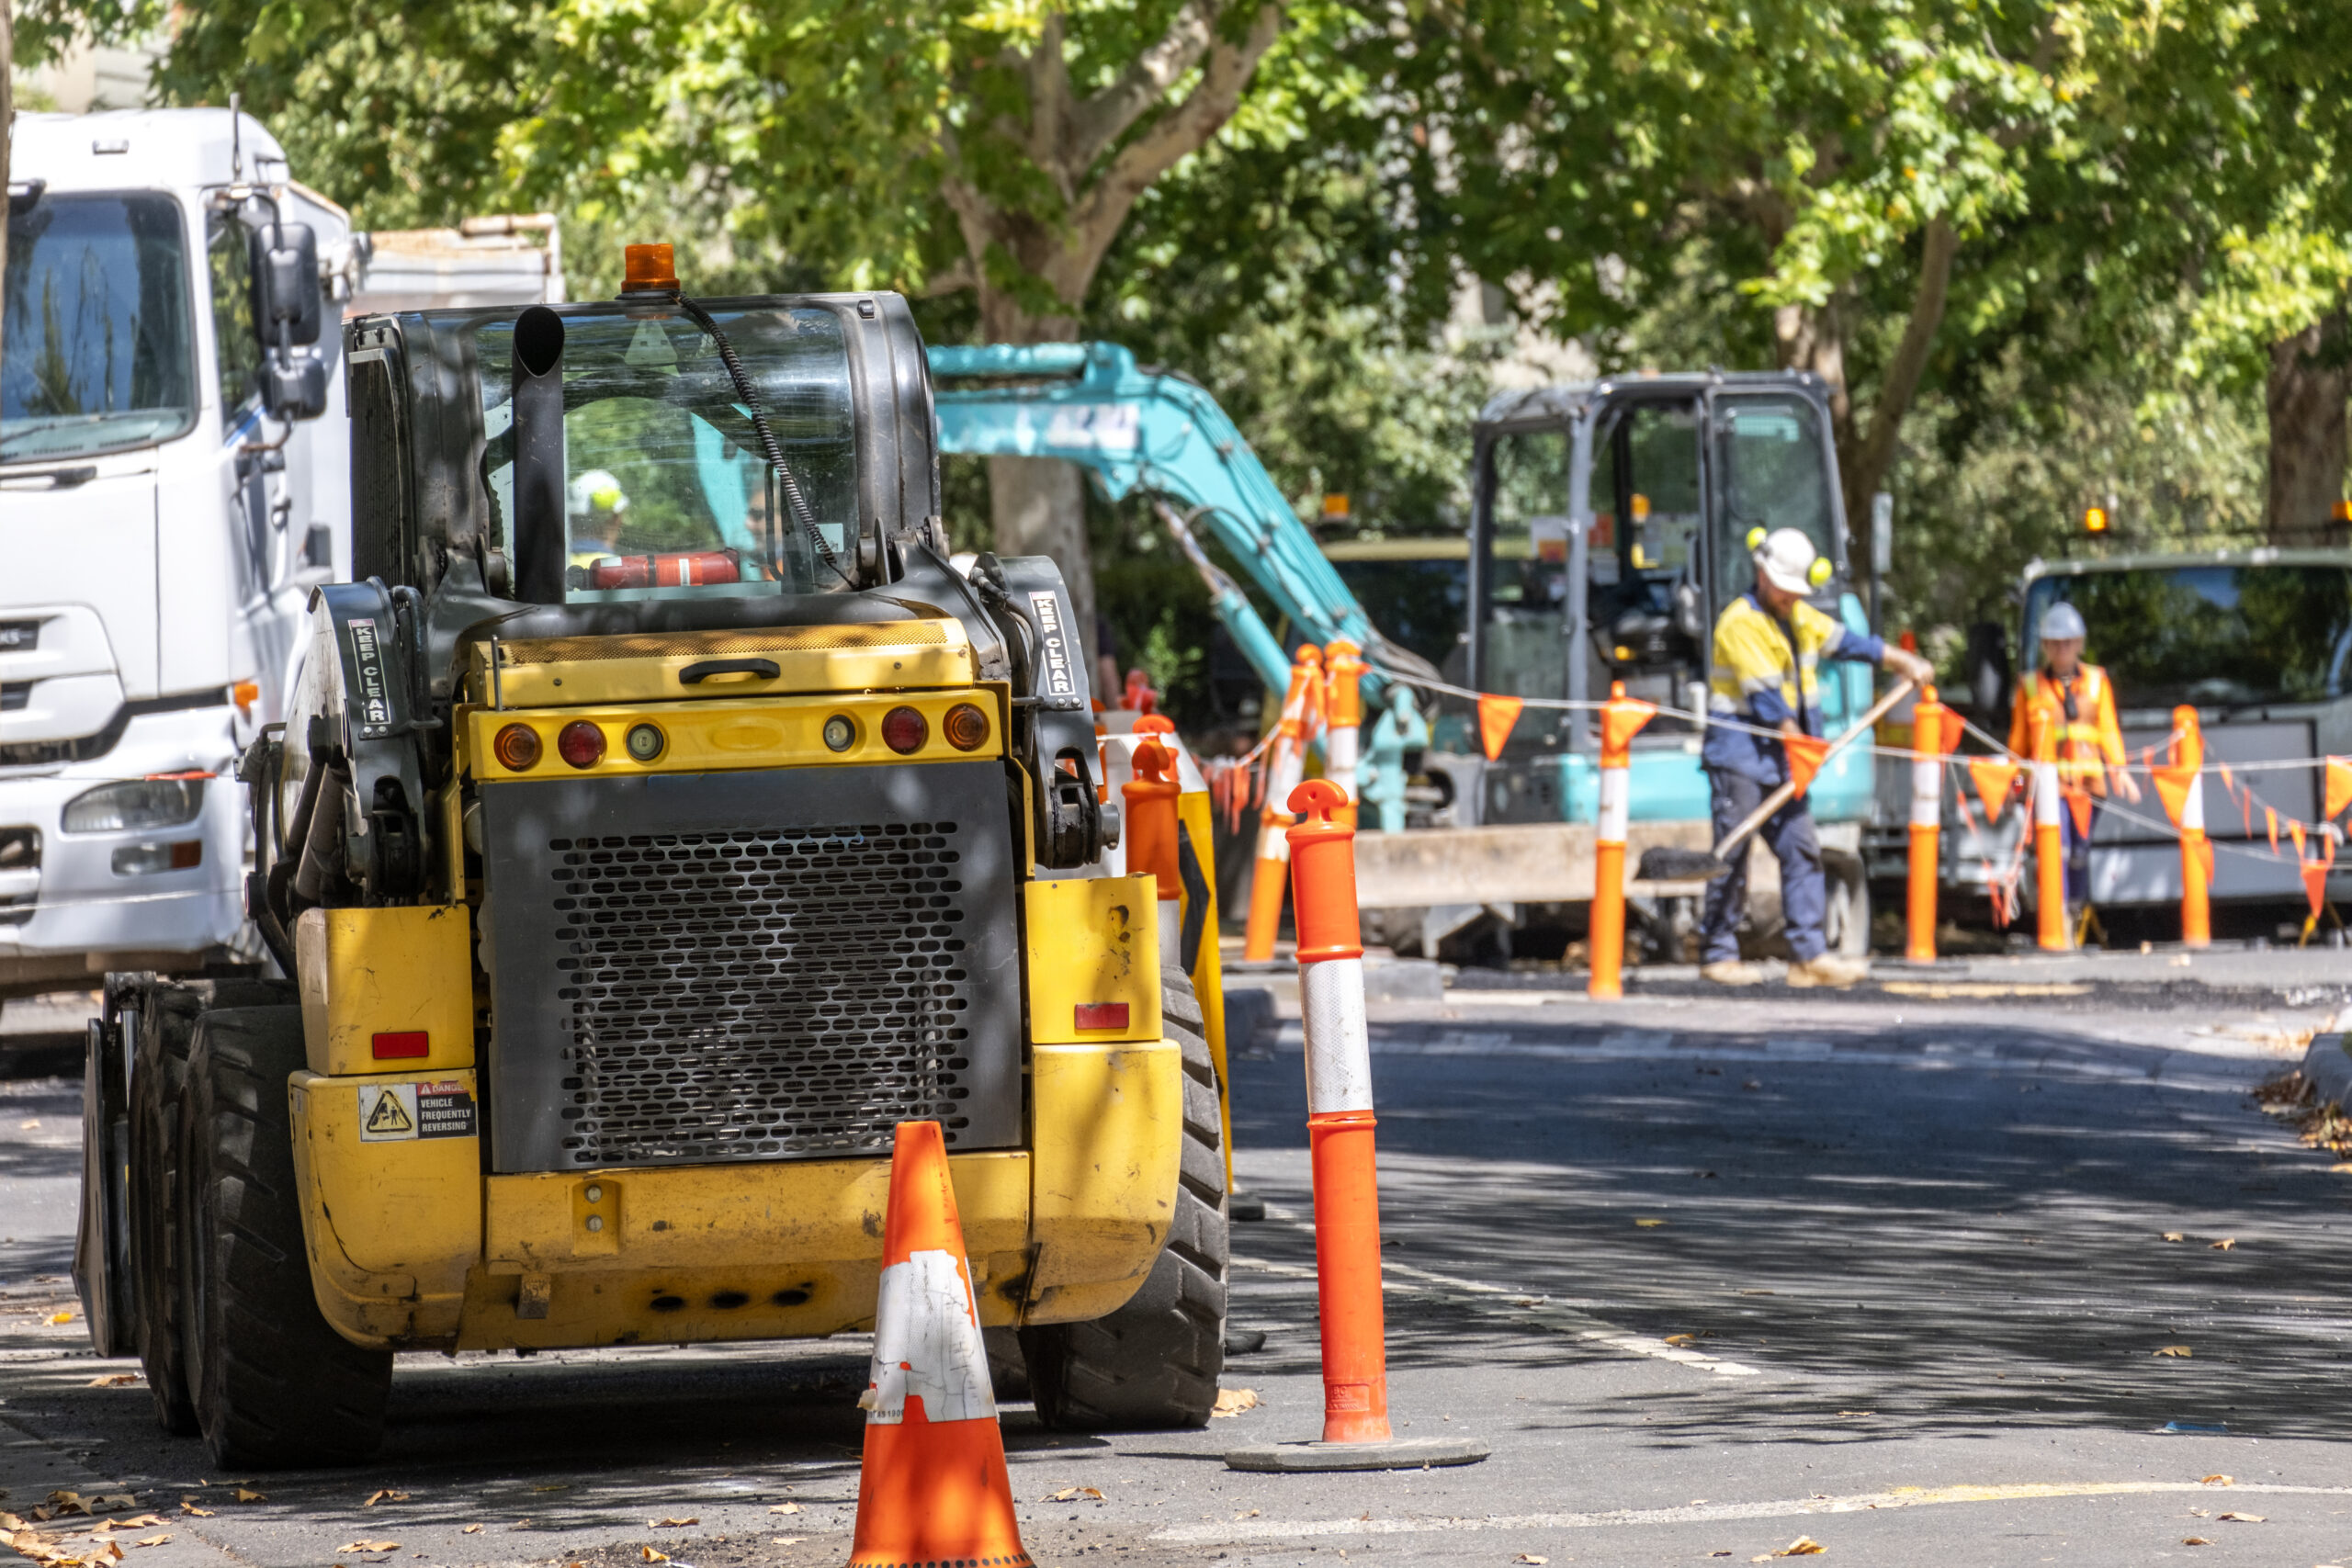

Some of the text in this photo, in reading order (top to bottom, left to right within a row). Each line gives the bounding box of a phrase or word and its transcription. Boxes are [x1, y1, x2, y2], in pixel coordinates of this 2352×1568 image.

[1036, 600, 1069, 693] KEEP CLEAR
[356, 627, 385, 721] KEEP CLEAR
[421, 1098, 453, 1109] VEHICLE
[421, 1109, 471, 1121] FREQUENTLY
[422, 1121, 467, 1133] REVERSING
